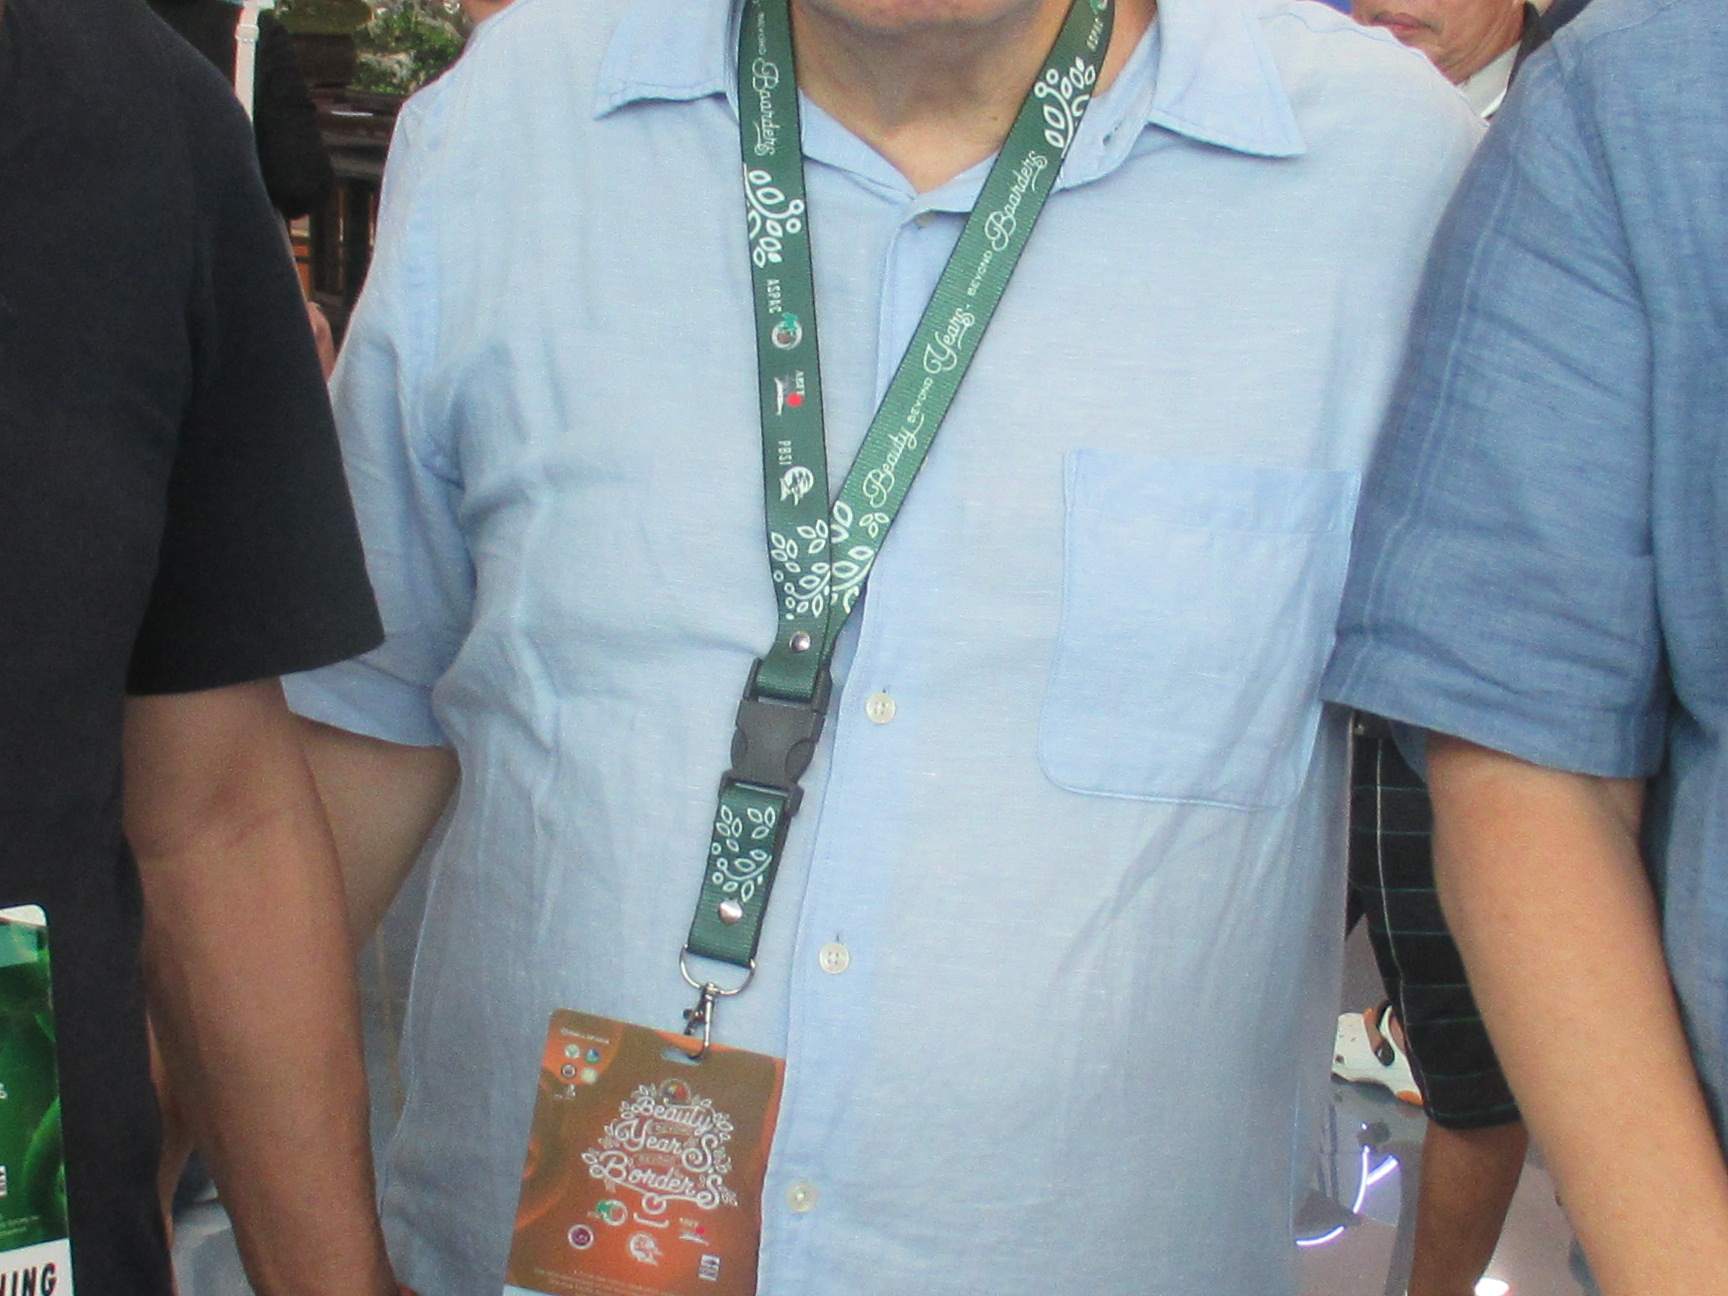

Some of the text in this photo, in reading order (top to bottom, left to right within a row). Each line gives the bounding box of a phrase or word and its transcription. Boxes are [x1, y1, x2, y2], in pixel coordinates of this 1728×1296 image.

[766, 278, 783, 314] ASPAC
[862, 413, 925, 509] Beauty
[907, 376, 934, 424] BEYOND
[967, 249, 993, 297] BEYOND
[778, 439, 793, 466] PBSI
[631, 1095, 714, 1136] Beauty
